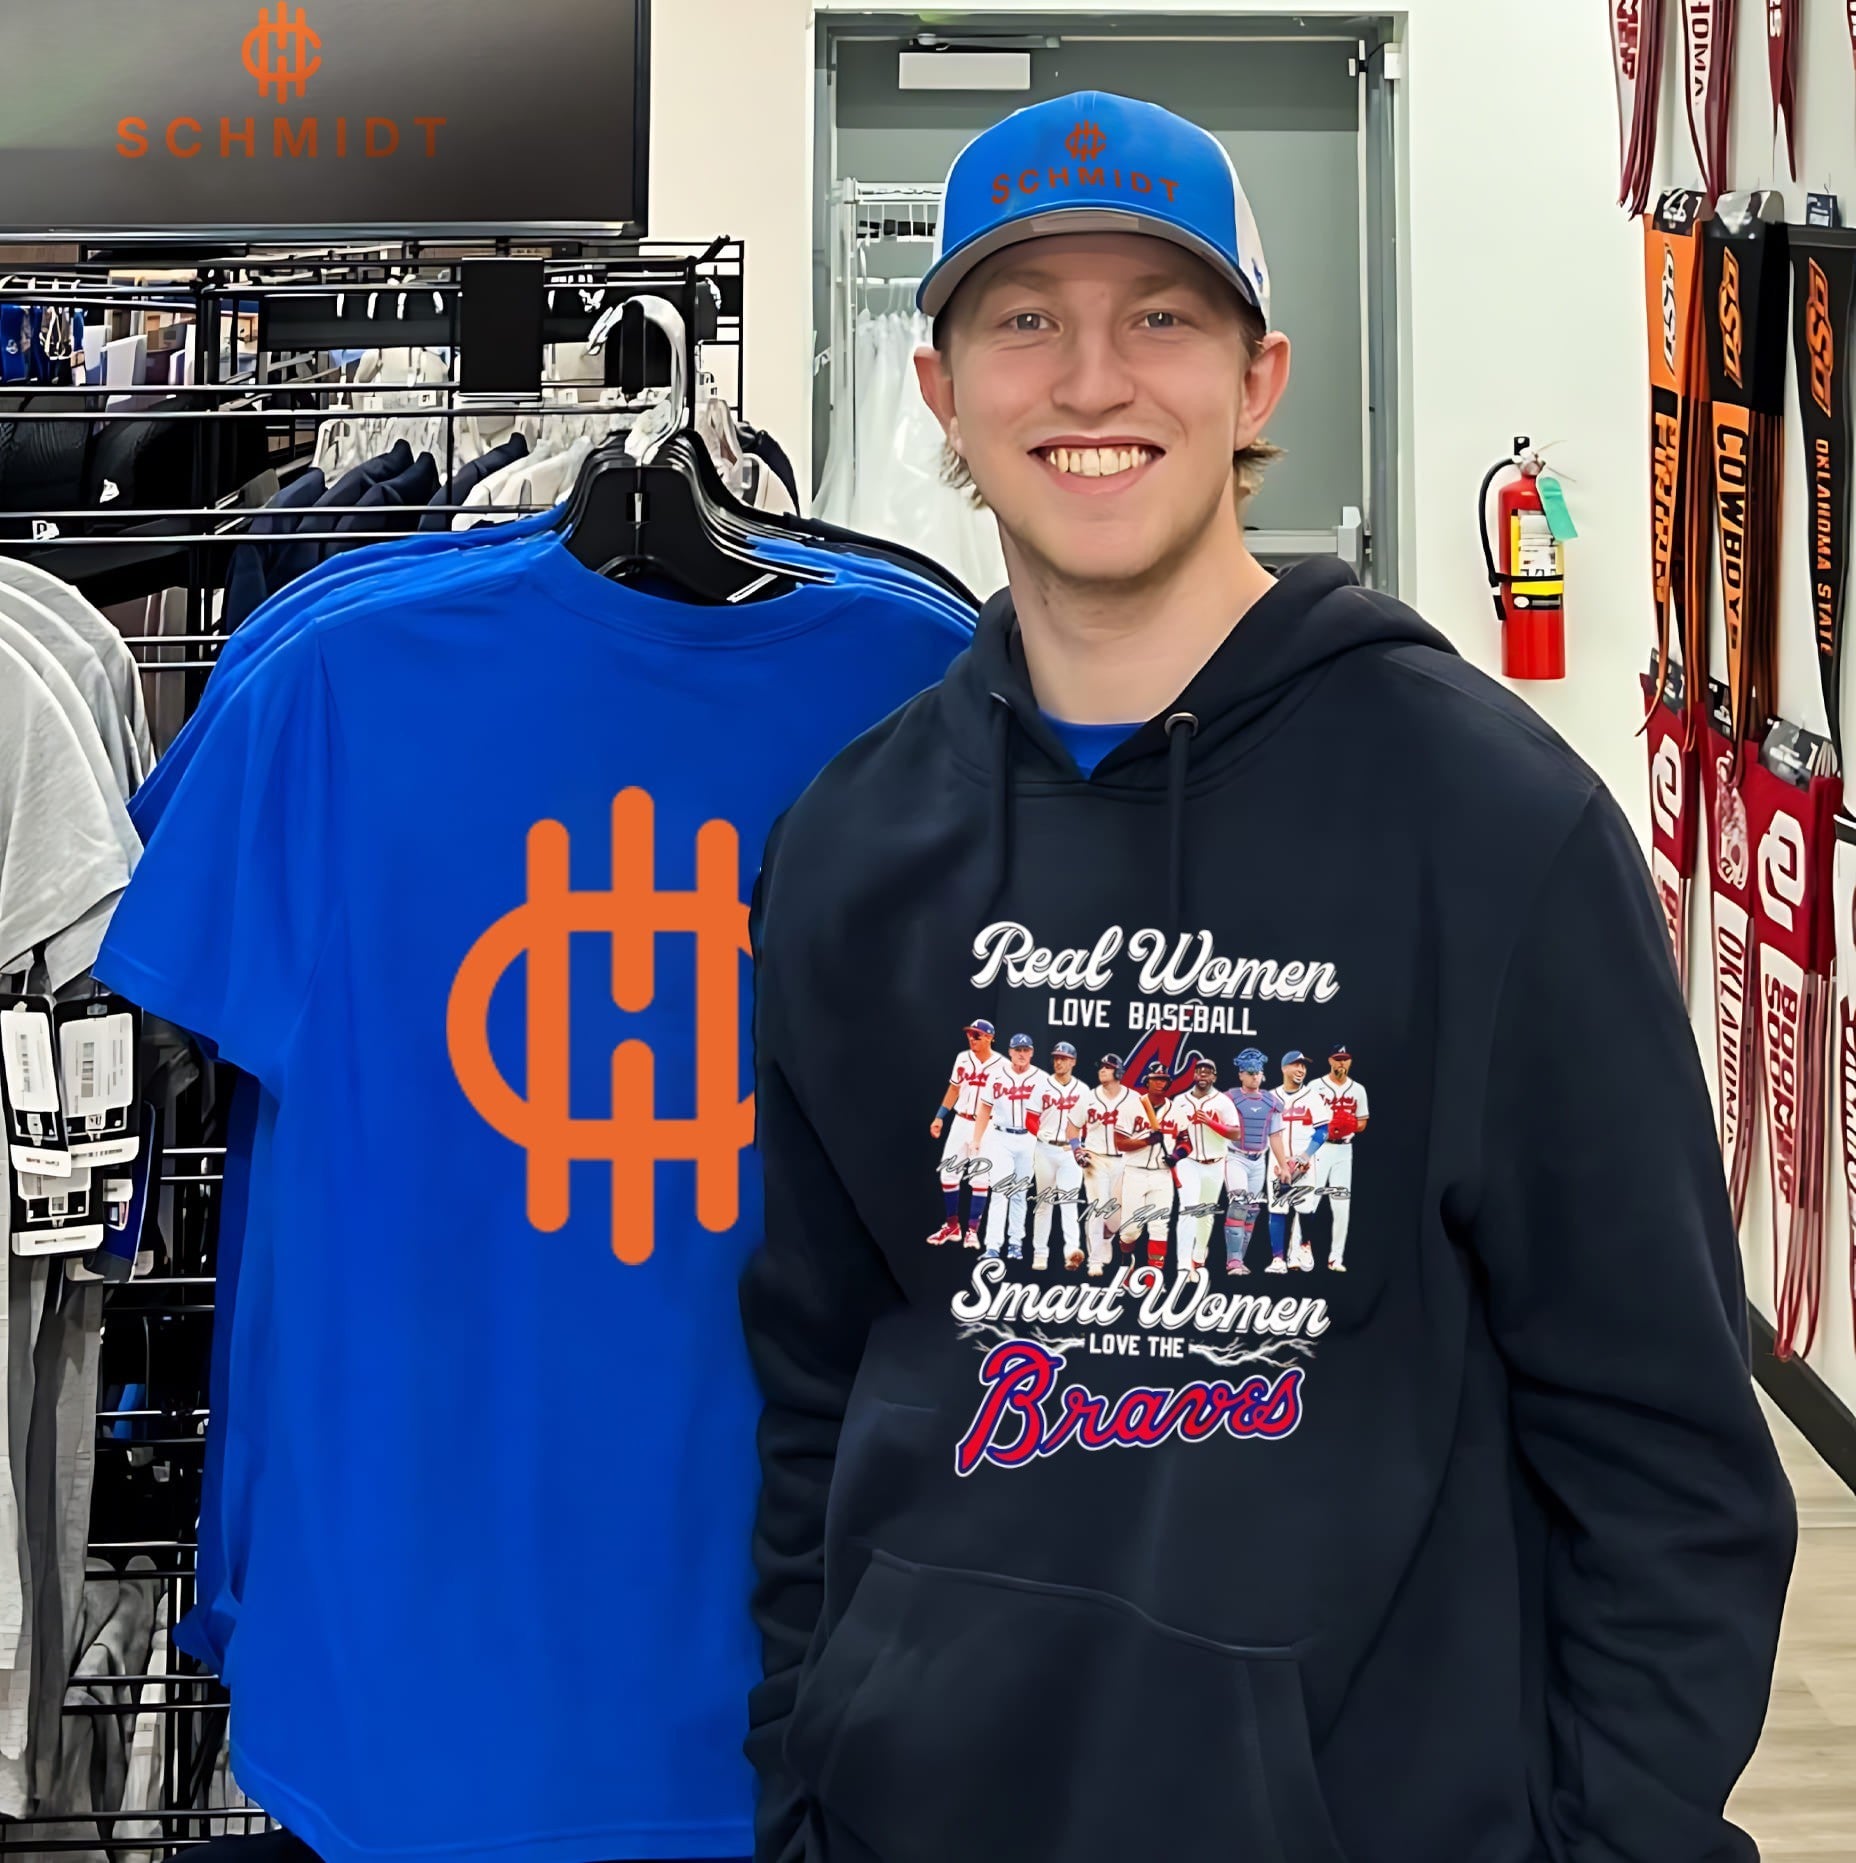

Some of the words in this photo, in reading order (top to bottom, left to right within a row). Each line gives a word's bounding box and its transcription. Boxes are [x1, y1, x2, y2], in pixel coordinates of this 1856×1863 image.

[116, 116, 447, 159] SCHMIDT
[991, 167, 1179, 205] SCHMIDT
[970, 920, 1123, 991] Real
[1128, 929, 1341, 1003] Women
[1047, 997, 1111, 1028] LOVE
[1128, 1001, 1258, 1036] BASEBALL
[950, 1258, 1130, 1326] Smart
[1128, 1266, 1331, 1337] Women
[1089, 1333, 1142, 1356] LOVE
[1147, 1336, 1185, 1358] THE
[954, 1339, 1306, 1477] Braves
